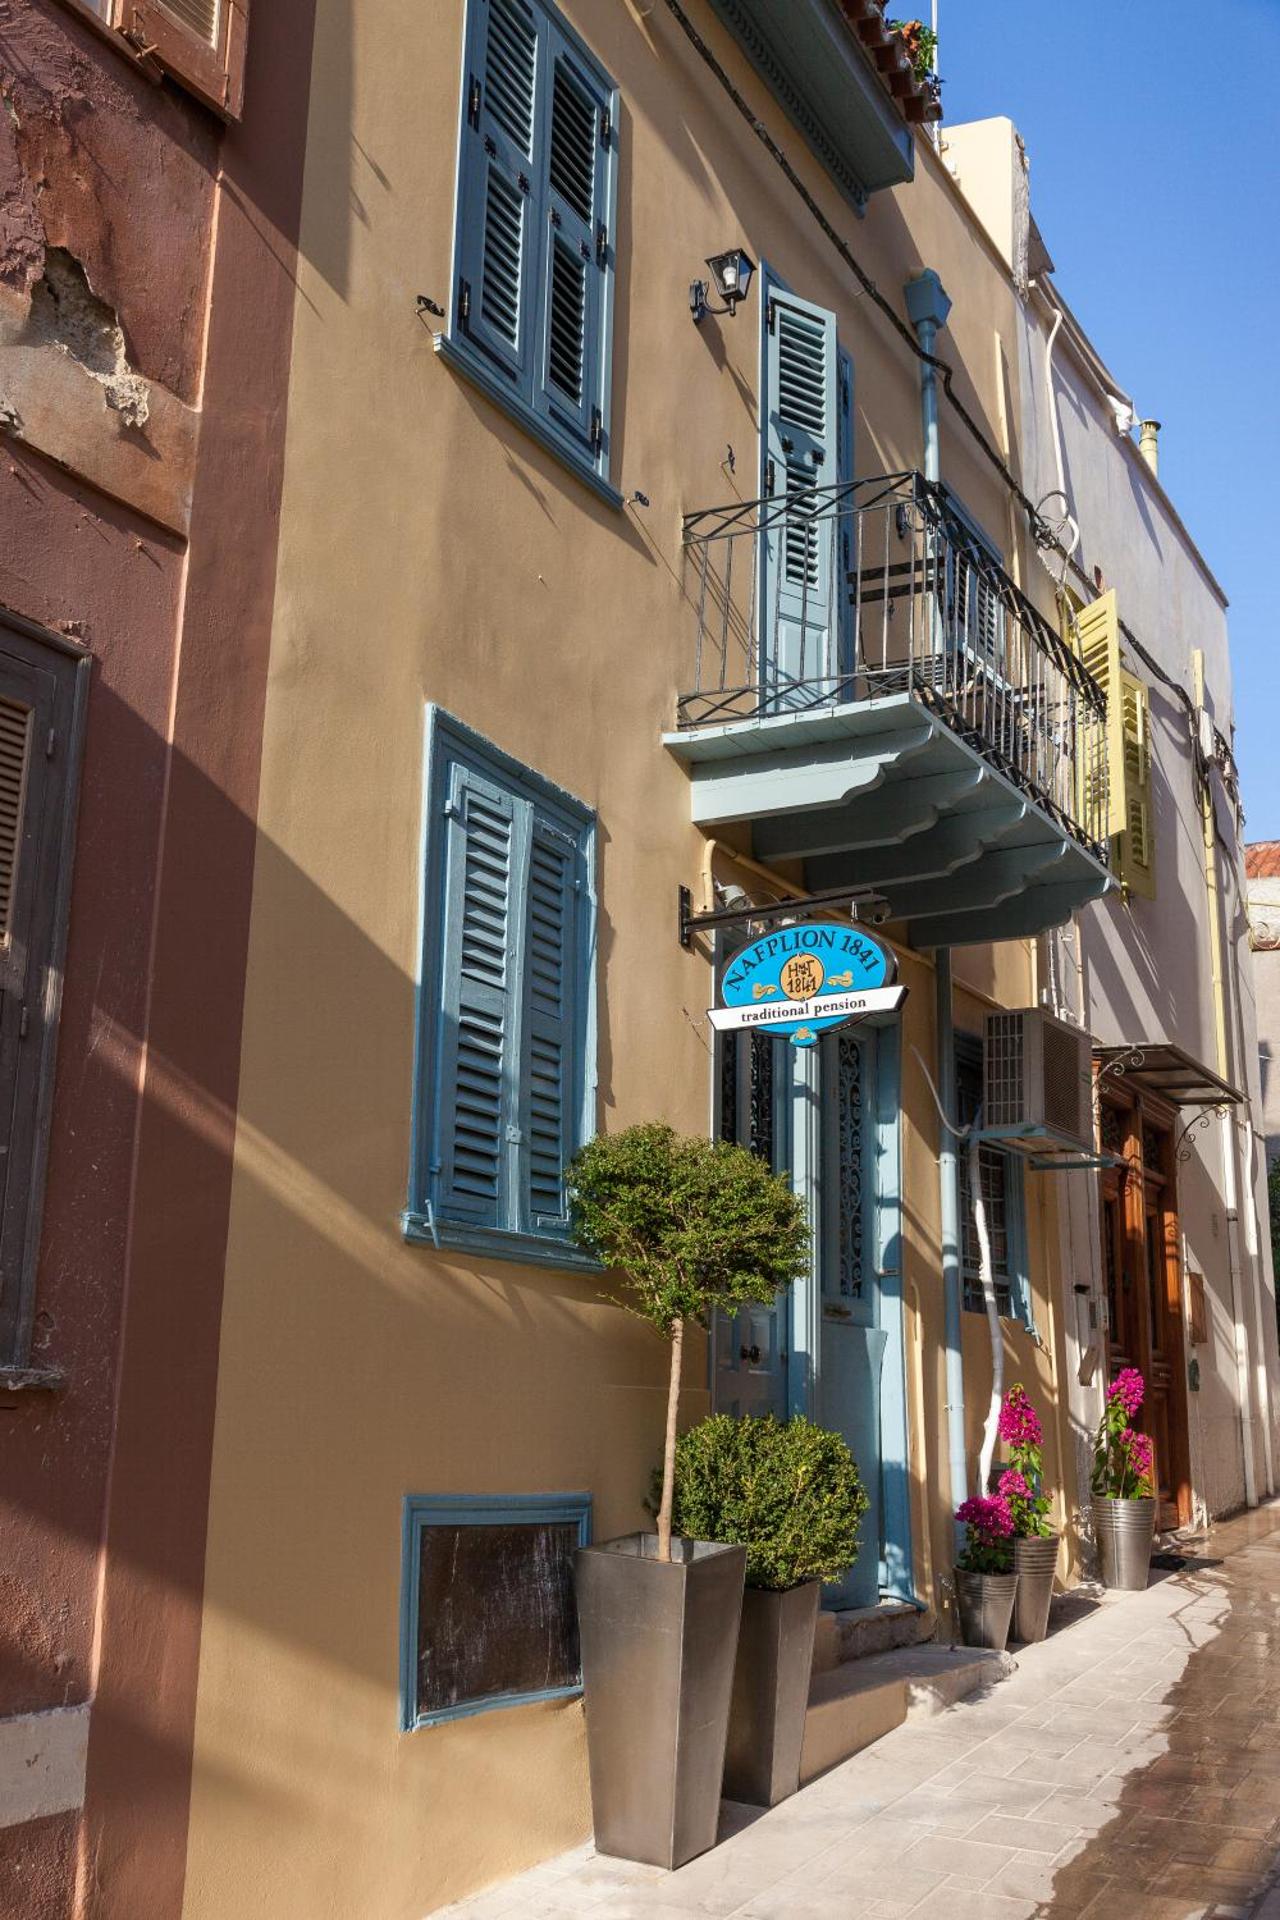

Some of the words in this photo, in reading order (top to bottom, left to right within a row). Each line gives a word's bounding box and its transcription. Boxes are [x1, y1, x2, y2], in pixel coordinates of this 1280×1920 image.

[726, 930, 836, 991] NAFPLION
[840, 935, 880, 972] 1841
[786, 976, 817, 993] 1841
[741, 1003, 810, 1022] traditional
[814, 998, 867, 1017] pension
